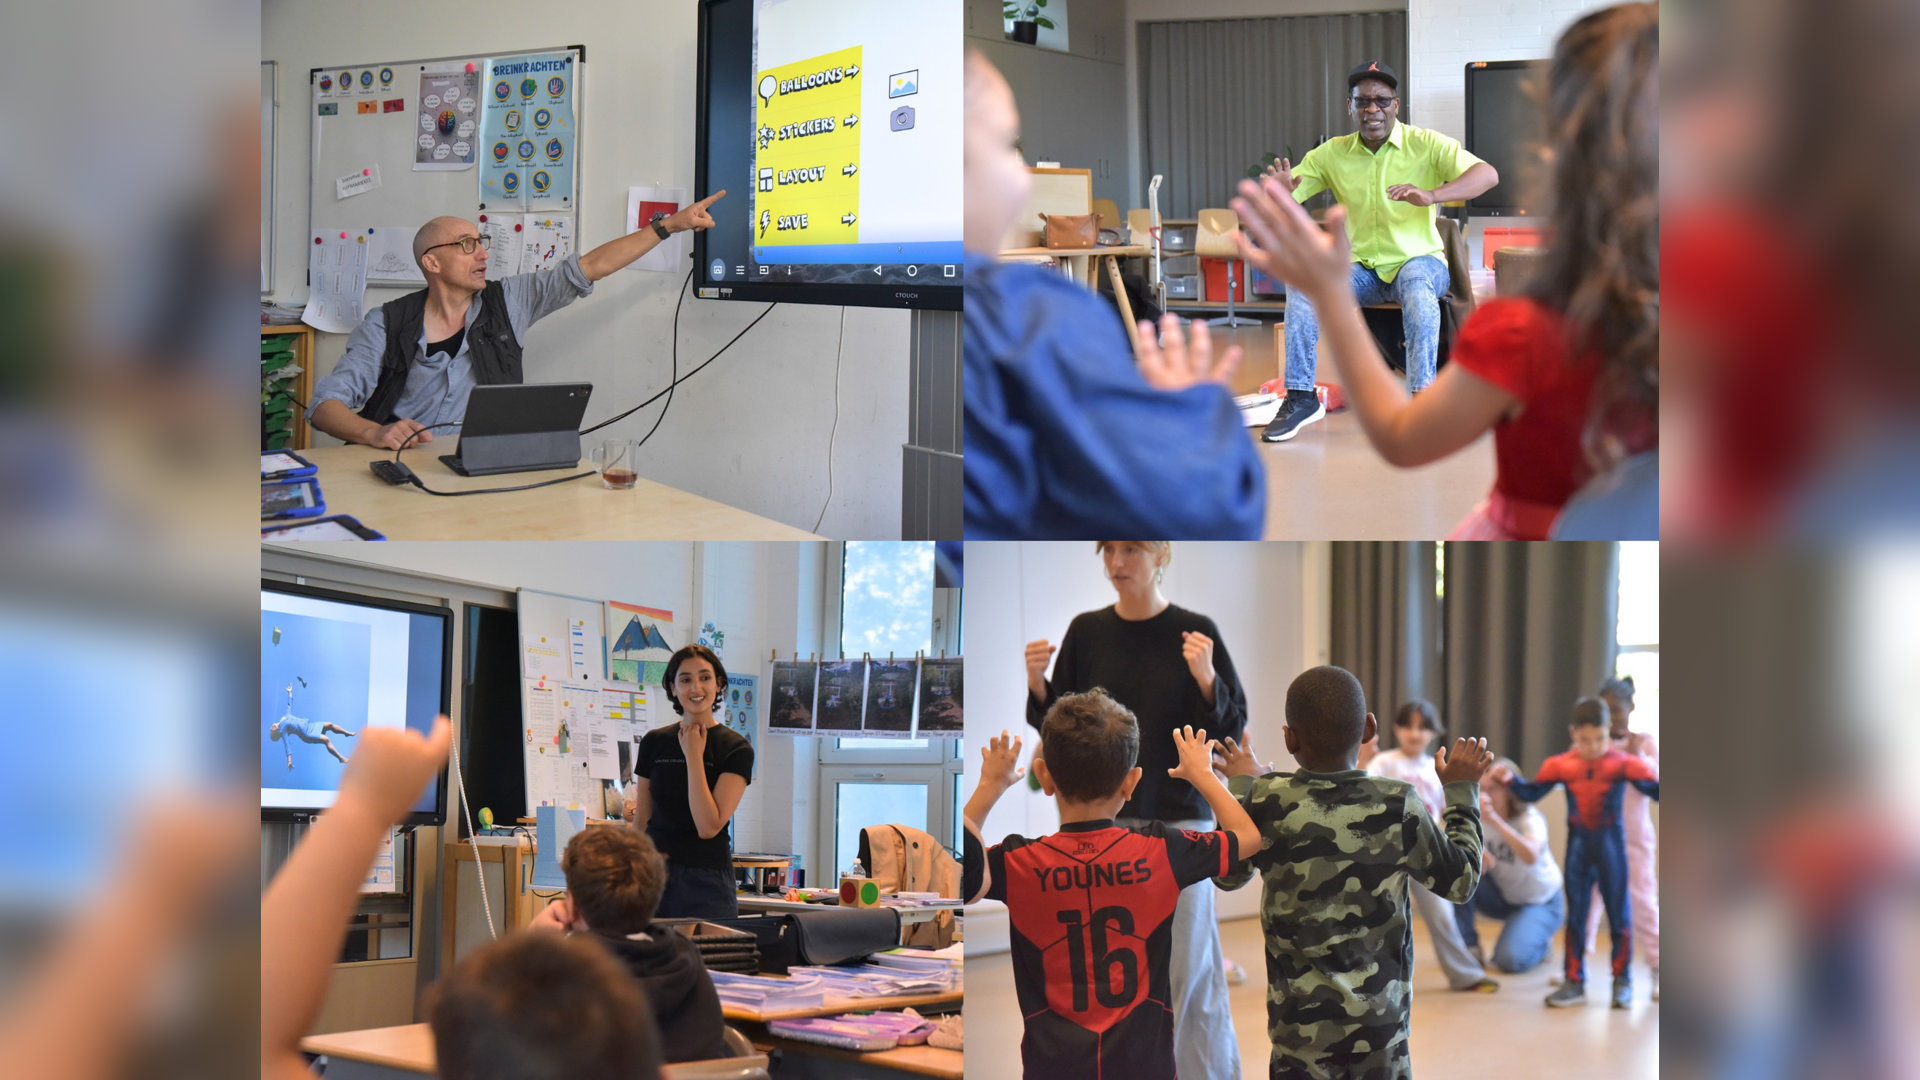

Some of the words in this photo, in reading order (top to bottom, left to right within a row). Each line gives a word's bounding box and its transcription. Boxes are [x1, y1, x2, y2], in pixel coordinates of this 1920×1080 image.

[494, 61, 566, 76] BREINKRACHTEN
[779, 67, 843, 96] BALLOONS
[778, 165, 826, 185] LAYOUT
[777, 213, 808, 231] SAVE
[1034, 858, 1152, 892] YOUNES
[1057, 905, 1138, 1013] 16
